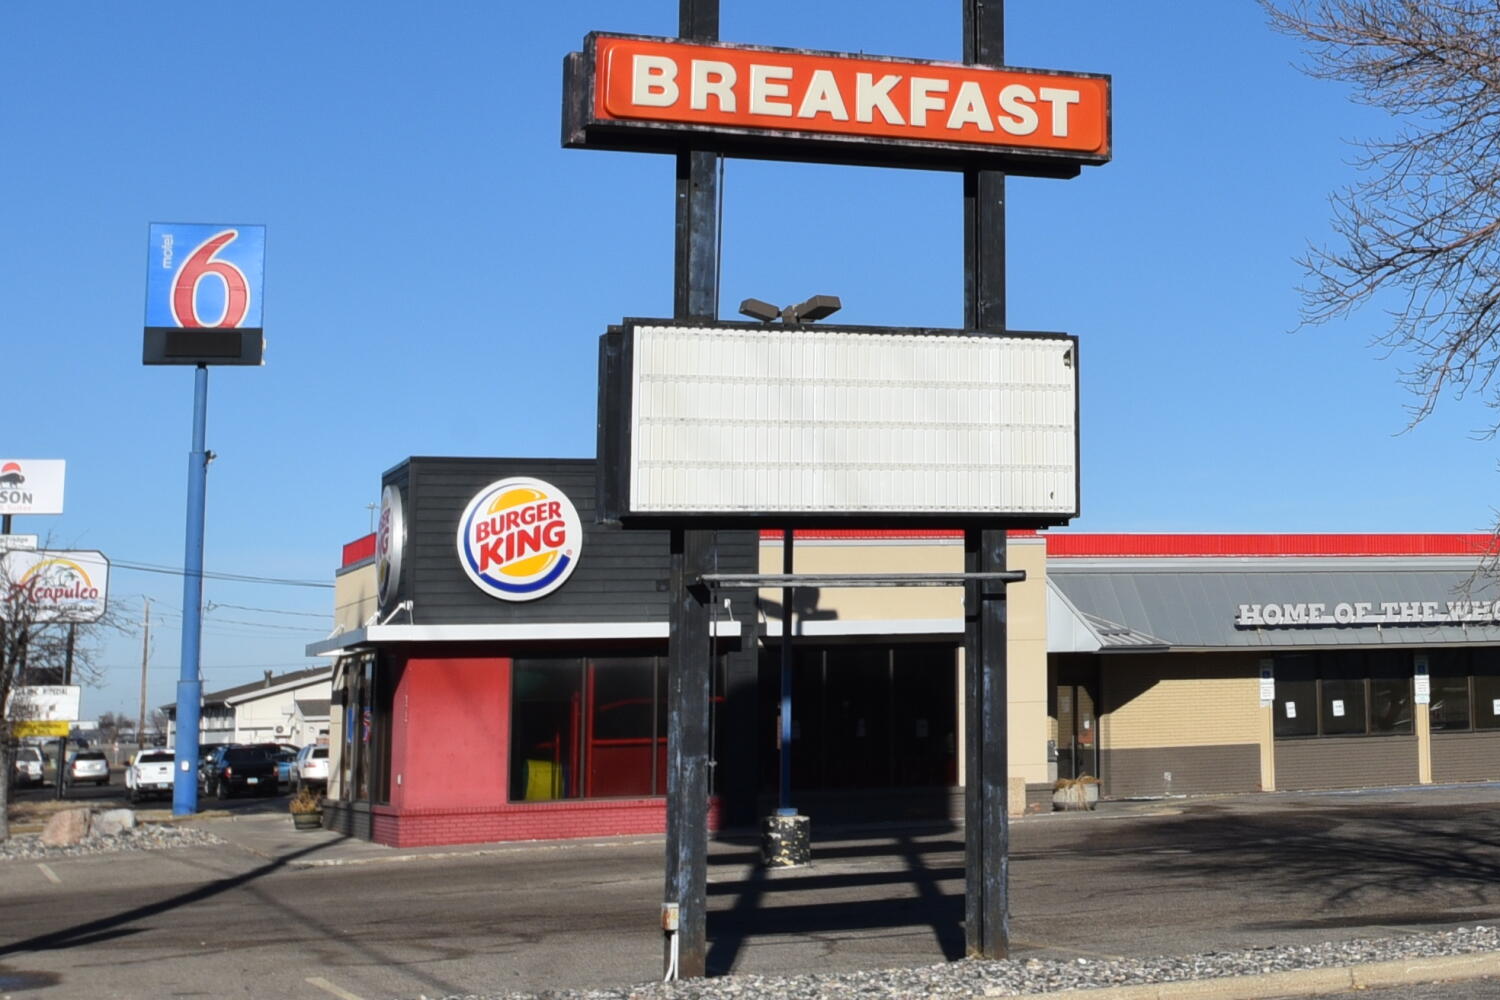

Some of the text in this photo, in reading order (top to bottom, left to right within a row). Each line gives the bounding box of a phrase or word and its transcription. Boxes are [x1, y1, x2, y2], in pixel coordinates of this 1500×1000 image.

[632, 55, 1080, 137] BREAKFAST
[162, 234, 173, 269] motel
[170, 229, 250, 328] 6
[476, 501, 561, 543] BURGER
[479, 520, 566, 573] KING
[4, 573, 99, 604] Acapulco
[1239, 603, 1325, 625] HOME
[1334, 602, 1372, 624] OF
[1381, 601, 1439, 623] THE
